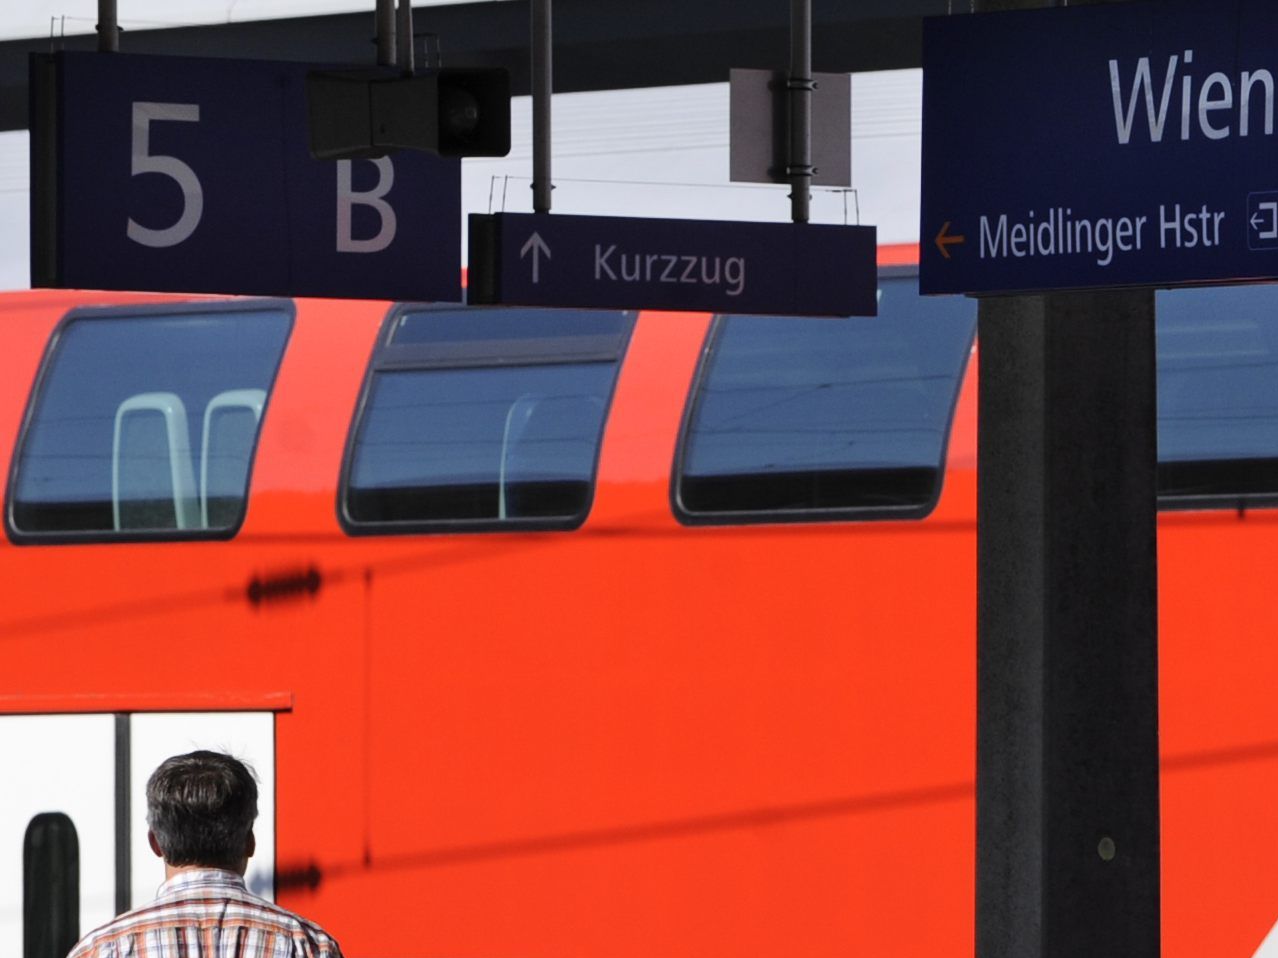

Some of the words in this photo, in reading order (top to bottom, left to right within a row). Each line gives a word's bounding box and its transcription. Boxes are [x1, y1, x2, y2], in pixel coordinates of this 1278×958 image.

[1109, 50, 1275, 145] Wien
[126, 102, 204, 248] 5
[336, 156, 397, 253] B
[594, 245, 745, 295] Kurzzug
[979, 207, 1147, 266] Meidlinger
[1159, 203, 1225, 249] Hstr
